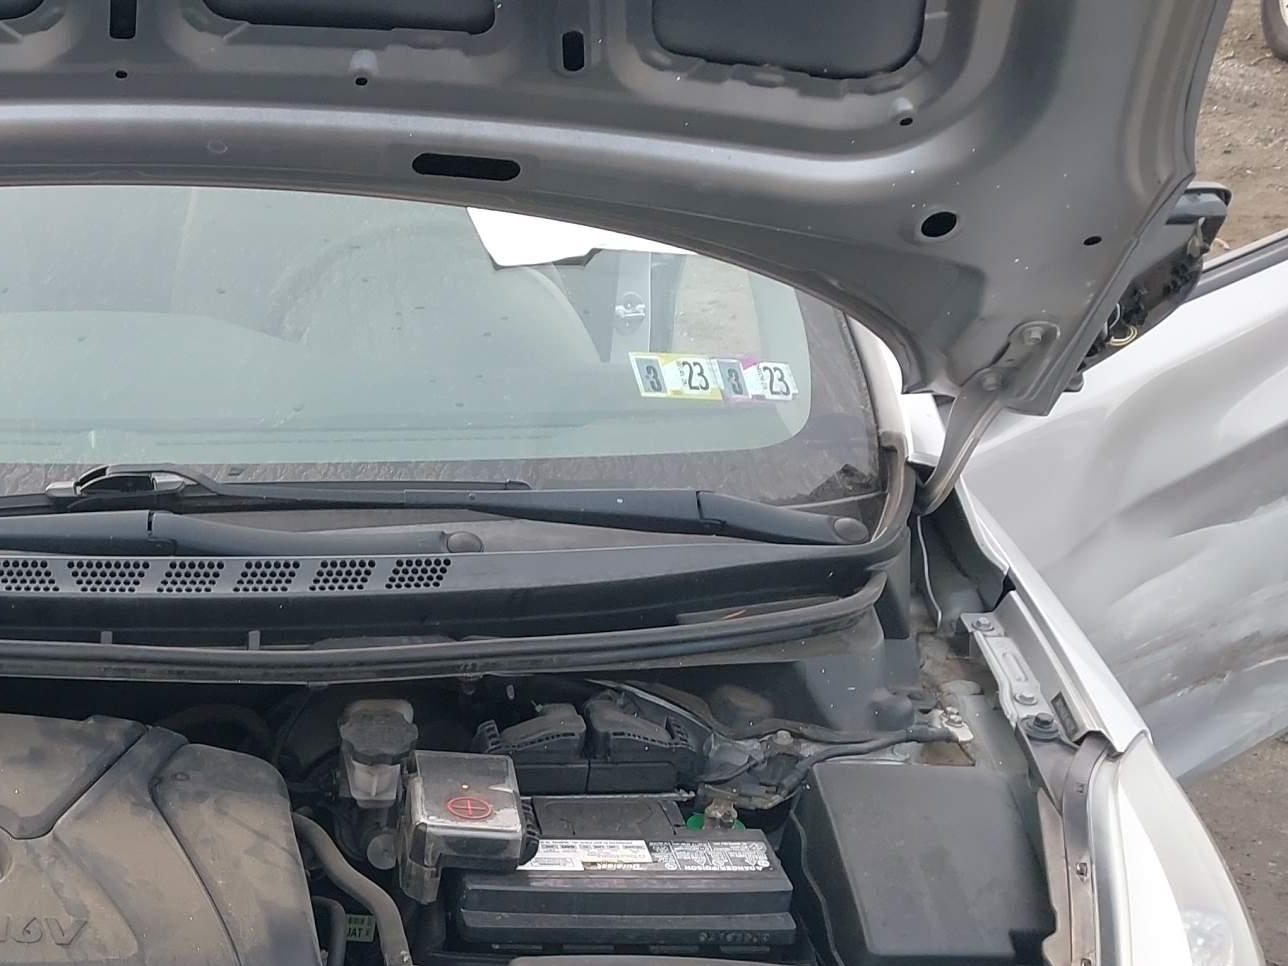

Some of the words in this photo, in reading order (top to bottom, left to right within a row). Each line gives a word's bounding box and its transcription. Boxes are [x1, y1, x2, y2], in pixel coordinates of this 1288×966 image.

[645, 365, 662, 393] 3
[682, 361, 710, 391] 23
[727, 367, 743, 395] 3
[762, 366, 790, 396] 23
